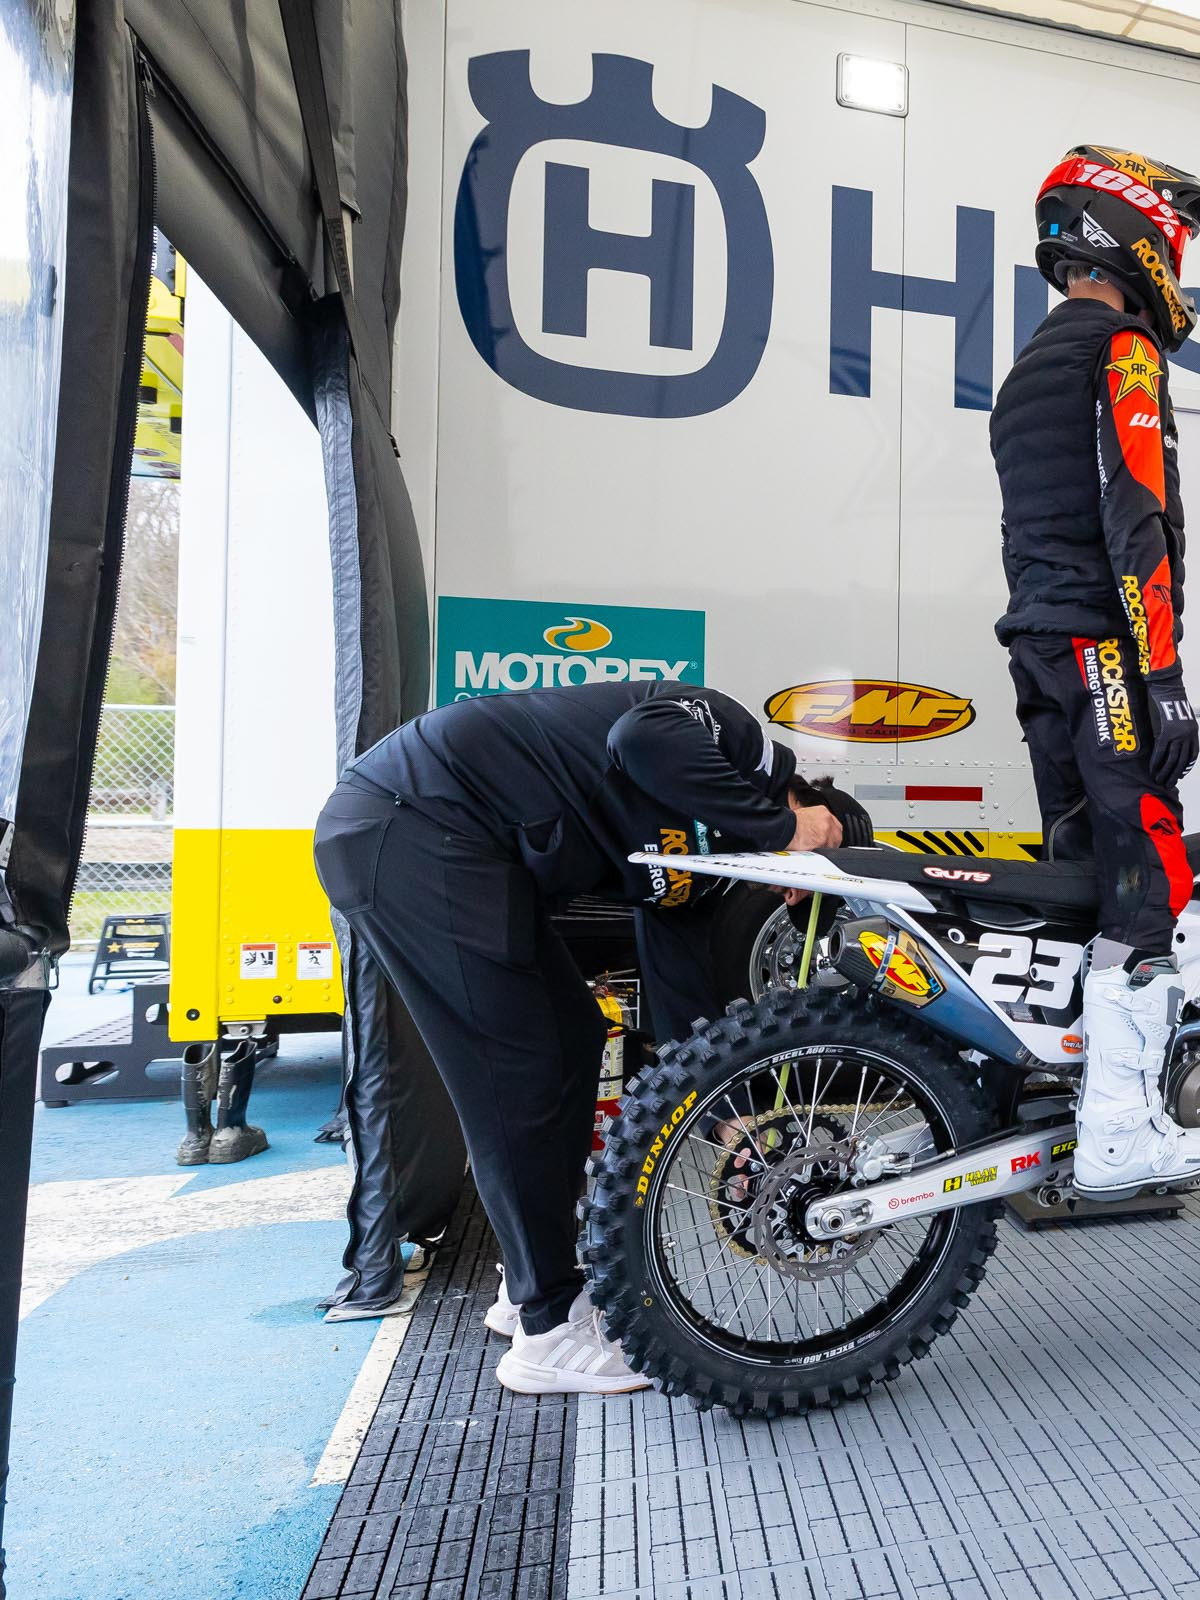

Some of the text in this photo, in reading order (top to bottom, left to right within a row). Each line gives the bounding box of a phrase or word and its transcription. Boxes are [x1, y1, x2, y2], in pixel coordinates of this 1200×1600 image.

[1076, 163, 1180, 239] 100%
[1084, 647, 1111, 742] ENERGY DRINK
[1098, 638, 1137, 752] ROCKSTAR
[769, 689, 973, 728] FMF
[1160, 700, 1194, 720] FLY
[923, 866, 991, 883] GUTS
[970, 932, 1084, 1010] 23
[772, 1049, 804, 1064] EXCEL
[636, 1090, 698, 1196] DUNLOP
[1052, 1139, 1078, 1156] EXC
[1010, 1151, 1041, 1172] RK
[965, 1166, 998, 1182] HAAN
[901, 1191, 935, 1206] brembo
